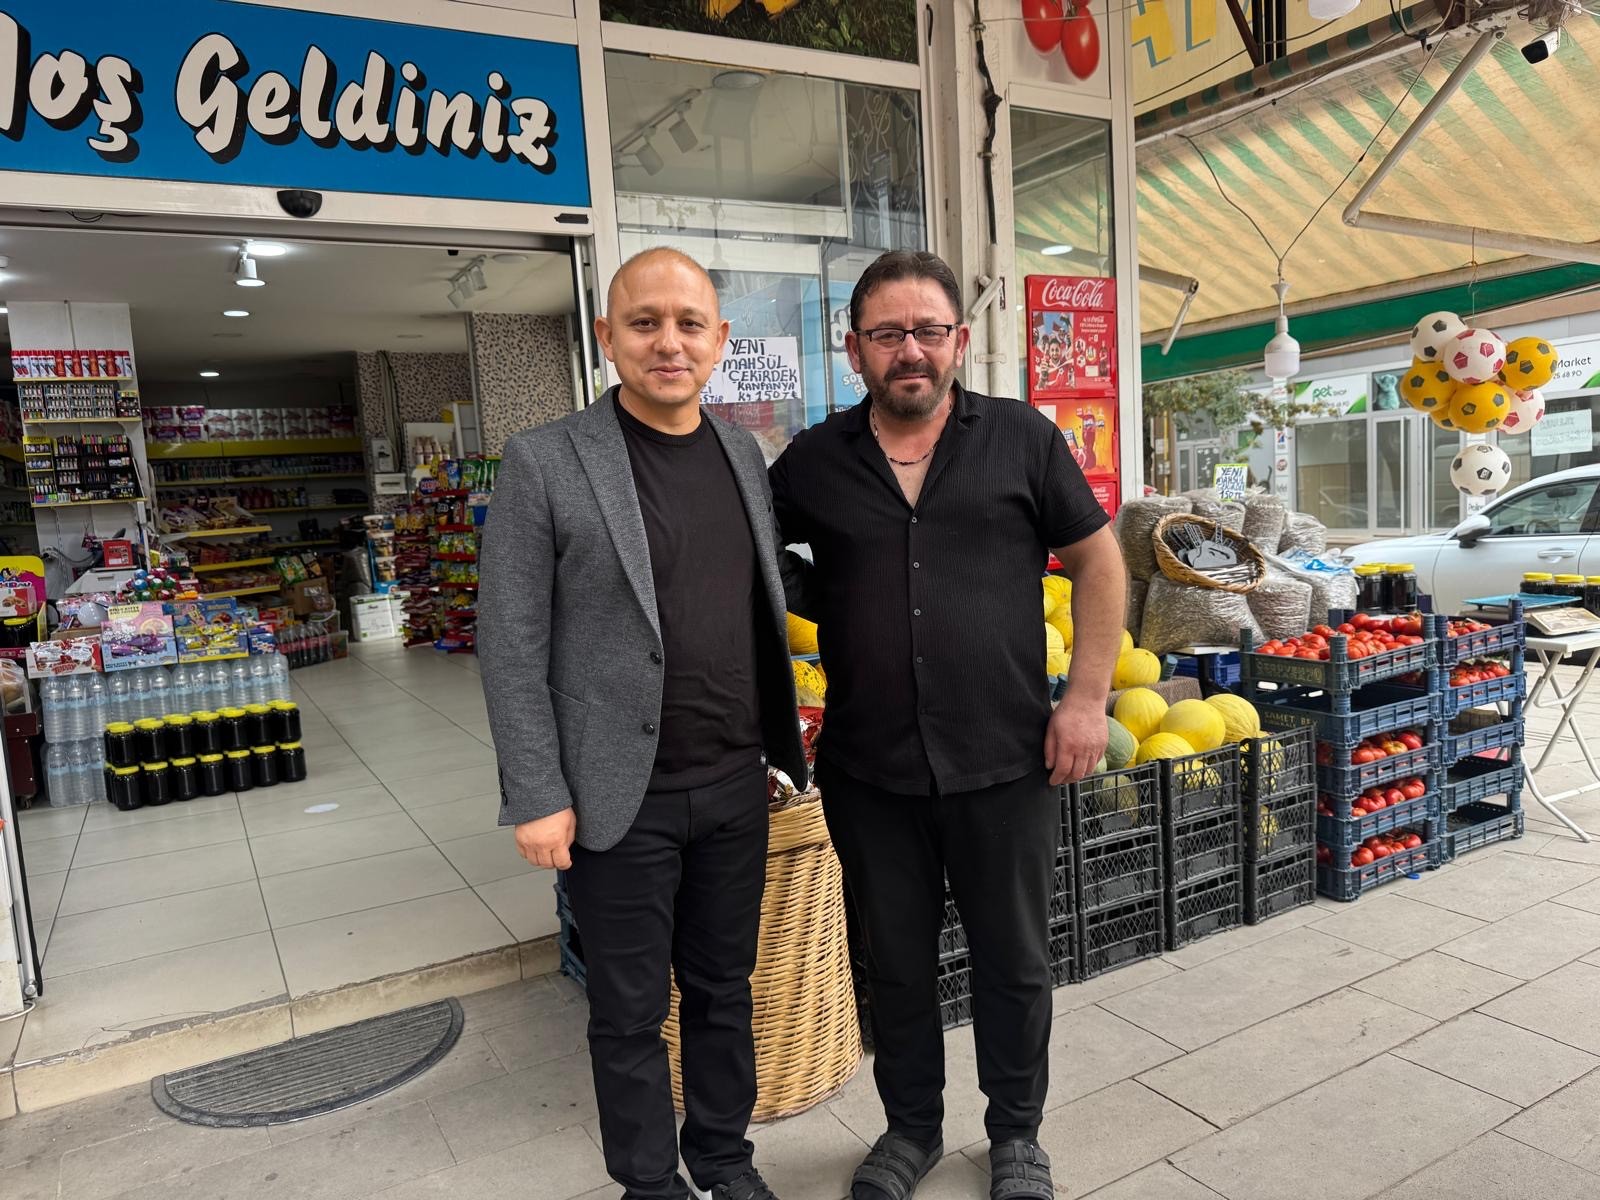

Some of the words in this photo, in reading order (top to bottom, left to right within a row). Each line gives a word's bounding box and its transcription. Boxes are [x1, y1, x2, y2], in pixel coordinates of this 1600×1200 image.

[175, 32, 555, 170] Geldiniz
[1042, 279, 1105, 307] Coca-Cola
[722, 354, 788, 372] MAHSÜL
[729, 368, 798, 384] ÇEKİRDEK
